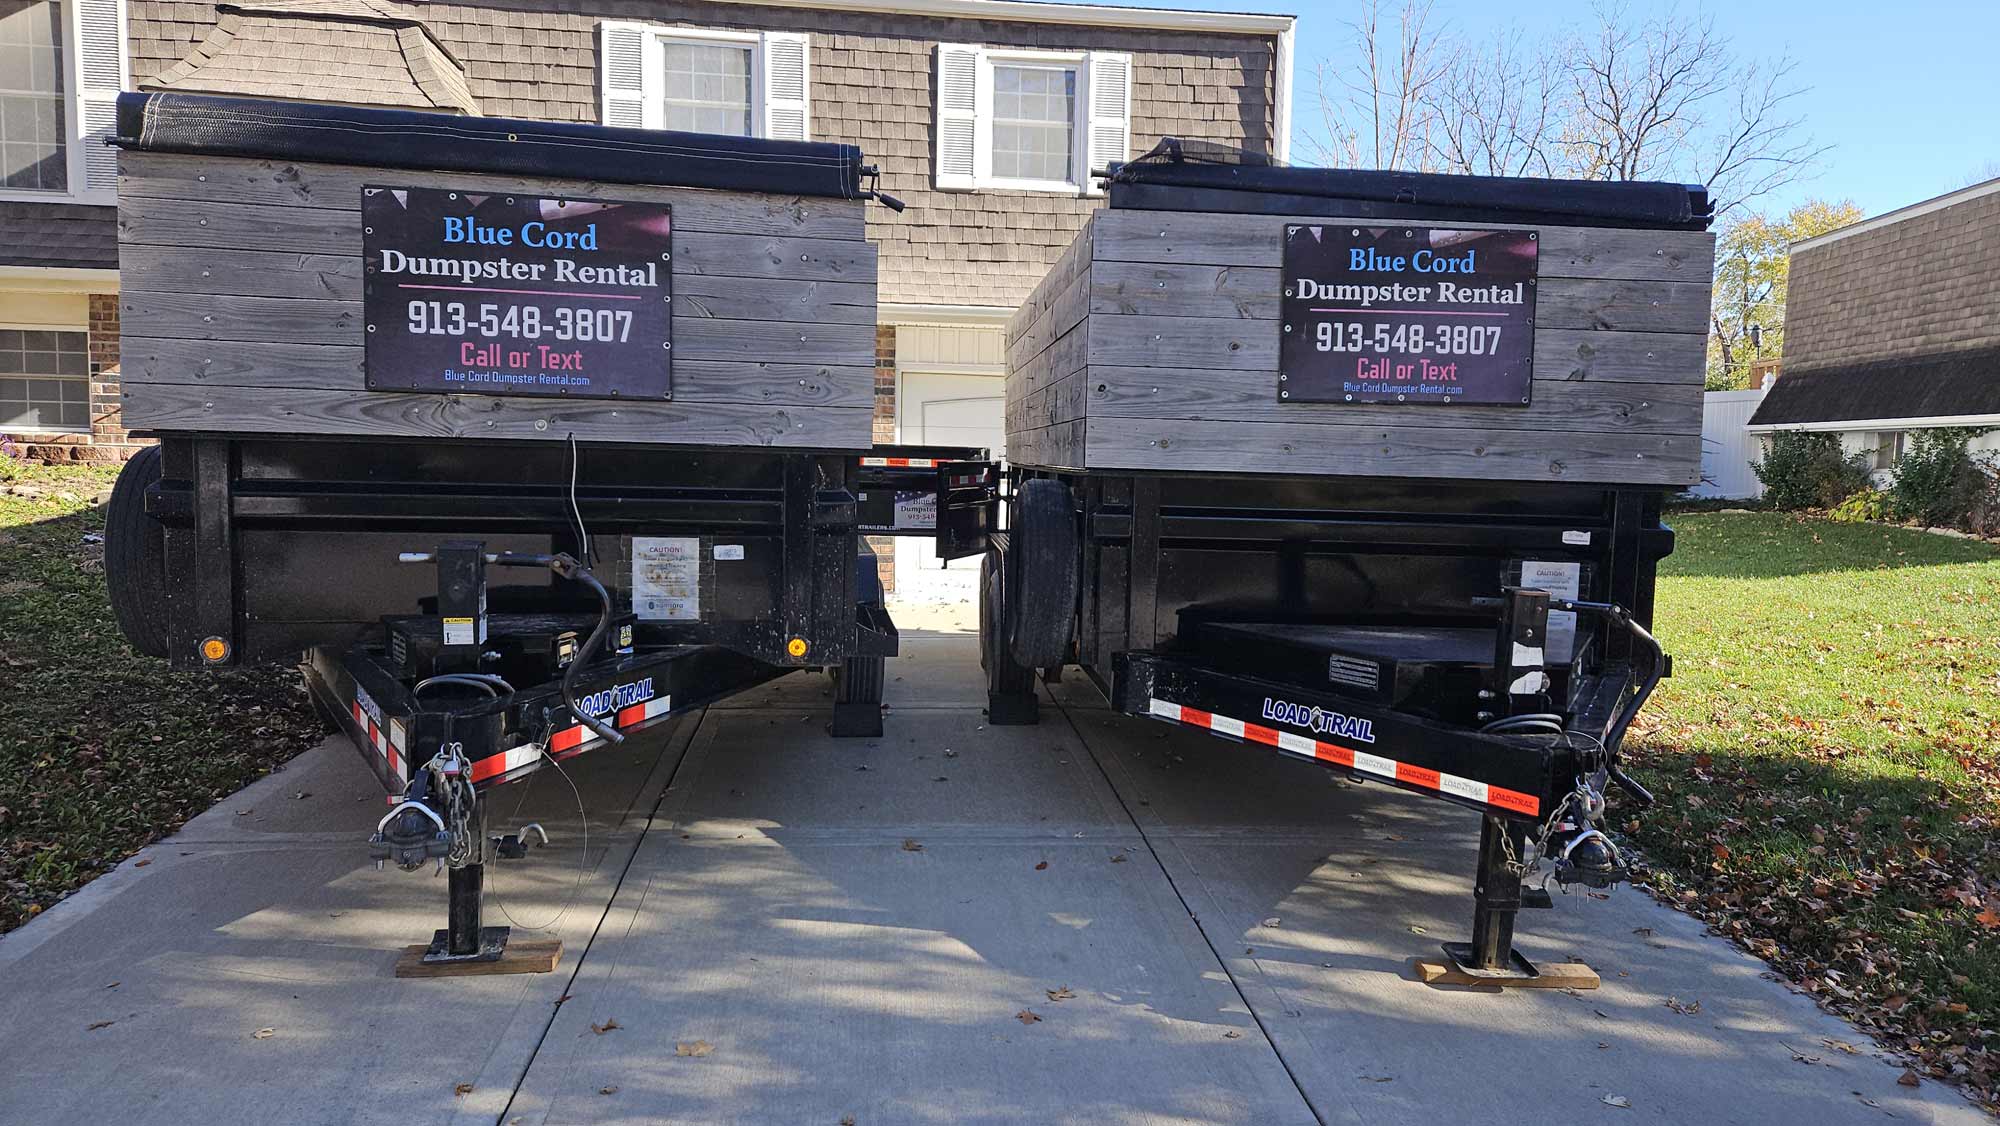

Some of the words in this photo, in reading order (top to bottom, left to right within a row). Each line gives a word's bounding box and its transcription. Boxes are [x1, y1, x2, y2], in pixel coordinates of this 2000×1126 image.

[443, 216, 512, 246] Blue
[521, 222, 598, 250] Cord
[380, 250, 545, 283] Dumpster
[554, 259, 658, 287] Rental
[1349, 248, 1405, 272] Blue
[1412, 250, 1475, 273] Cord
[1296, 279, 1431, 306] Dumpster
[1437, 283, 1523, 304] Rental
[408, 301, 633, 343] 913-548-3807
[1316, 323, 1501, 355] 913-548-3807
[461, 342, 500, 367] Call
[509, 350, 530, 368] or
[538, 346, 582, 370] Text
[1357, 358, 1390, 379] Call
[1396, 365, 1414, 379] or
[1420, 359, 1457, 381] Text
[445, 370, 464, 382] Blue
[468, 371, 490, 383] Cord
[492, 372, 537, 385] Dumpster
[539, 374, 590, 386] Rental.com
[1344, 382, 1361, 392] Blue
[1363, 383, 1380, 393] Cord
[1382, 383, 1419, 395] Dumpster
[1420, 384, 1463, 395] Rental.com
[618, 677, 655, 707] TRAIL
[1263, 698, 1311, 727] LOAD
[1320, 710, 1376, 744] TRAIL
